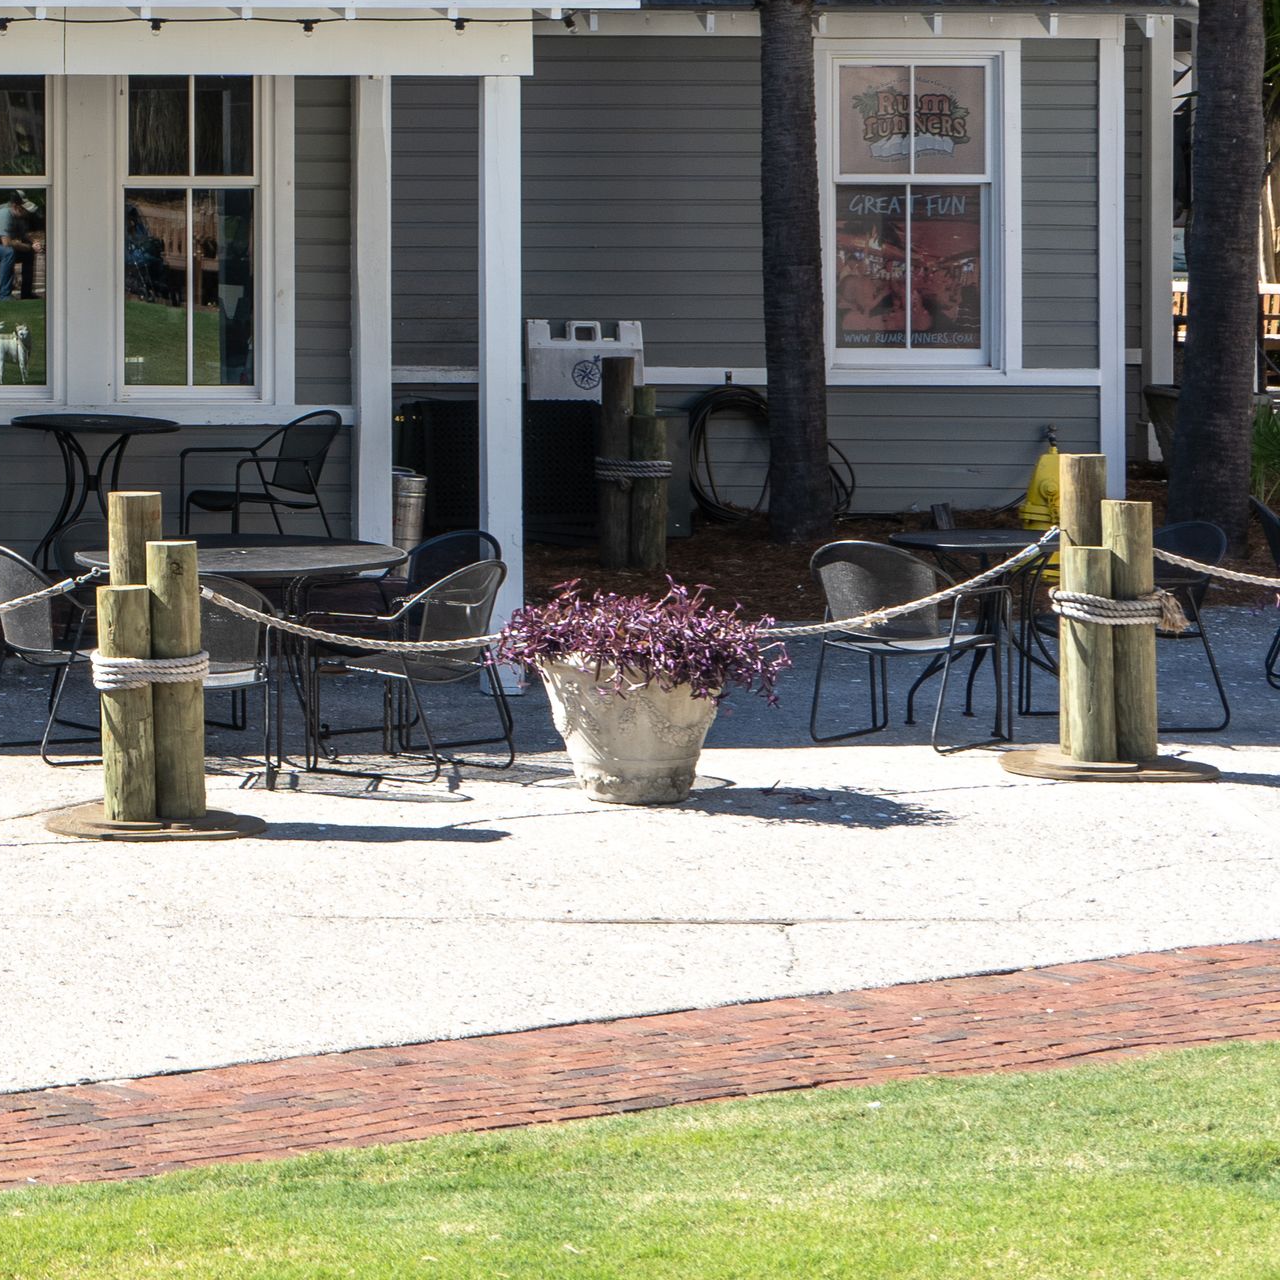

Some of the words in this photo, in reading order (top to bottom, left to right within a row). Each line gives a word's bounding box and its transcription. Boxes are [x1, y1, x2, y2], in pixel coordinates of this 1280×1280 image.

[877, 91, 951, 116] Rum
[849, 195, 922, 216] GREAT
[926, 195, 966, 216] FUN
